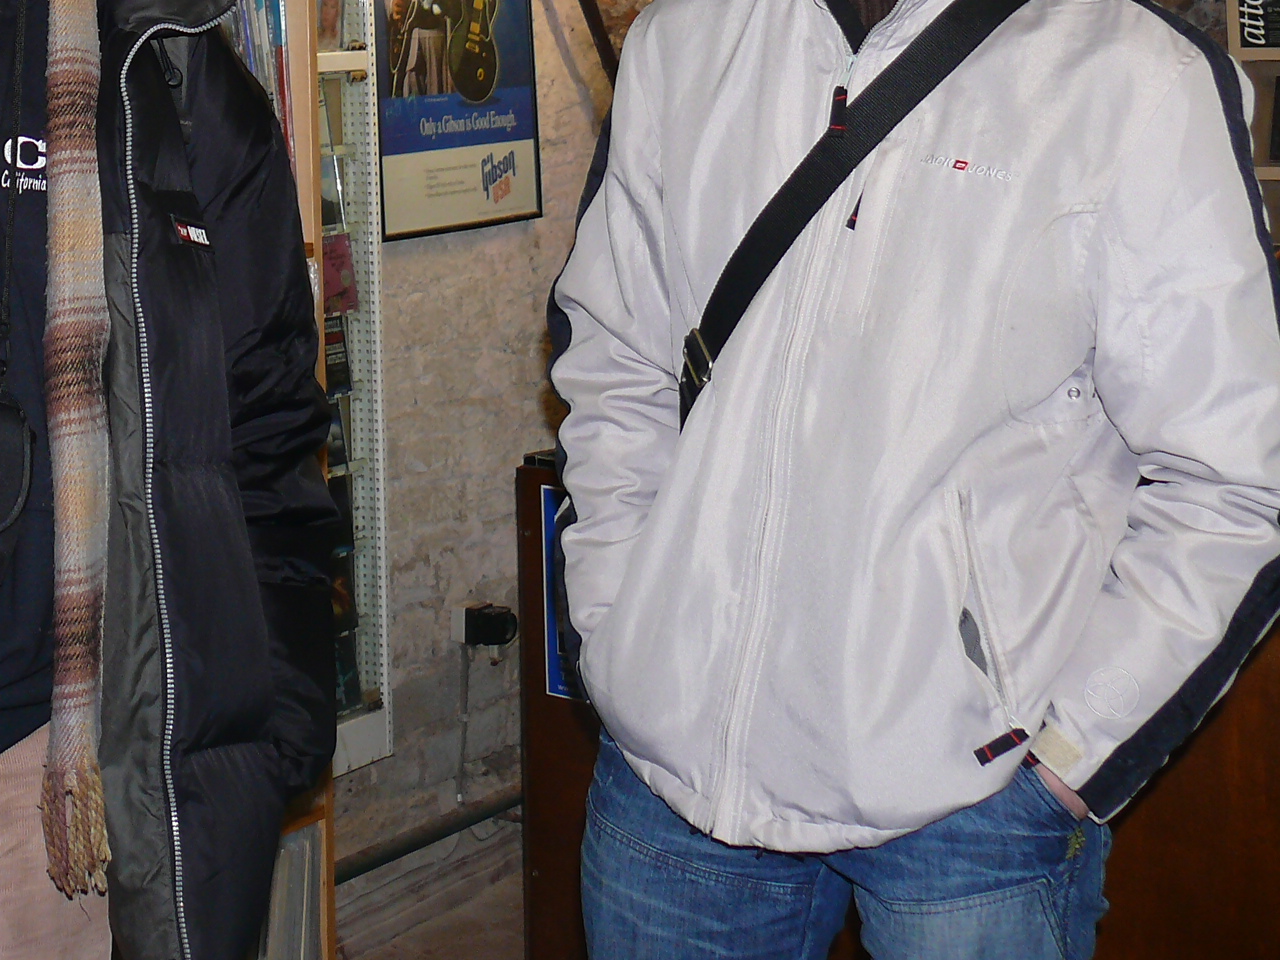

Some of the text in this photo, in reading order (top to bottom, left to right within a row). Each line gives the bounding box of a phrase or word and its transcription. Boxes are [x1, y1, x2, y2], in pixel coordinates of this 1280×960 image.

[420, 117, 436, 140] Only
[442, 114, 465, 133] Gibson
[472, 112, 490, 130] Good
[1, 170, 47, 194] Cifornia
[481, 150, 516, 201] Gibson
[967, 164, 1013, 181] JONES
